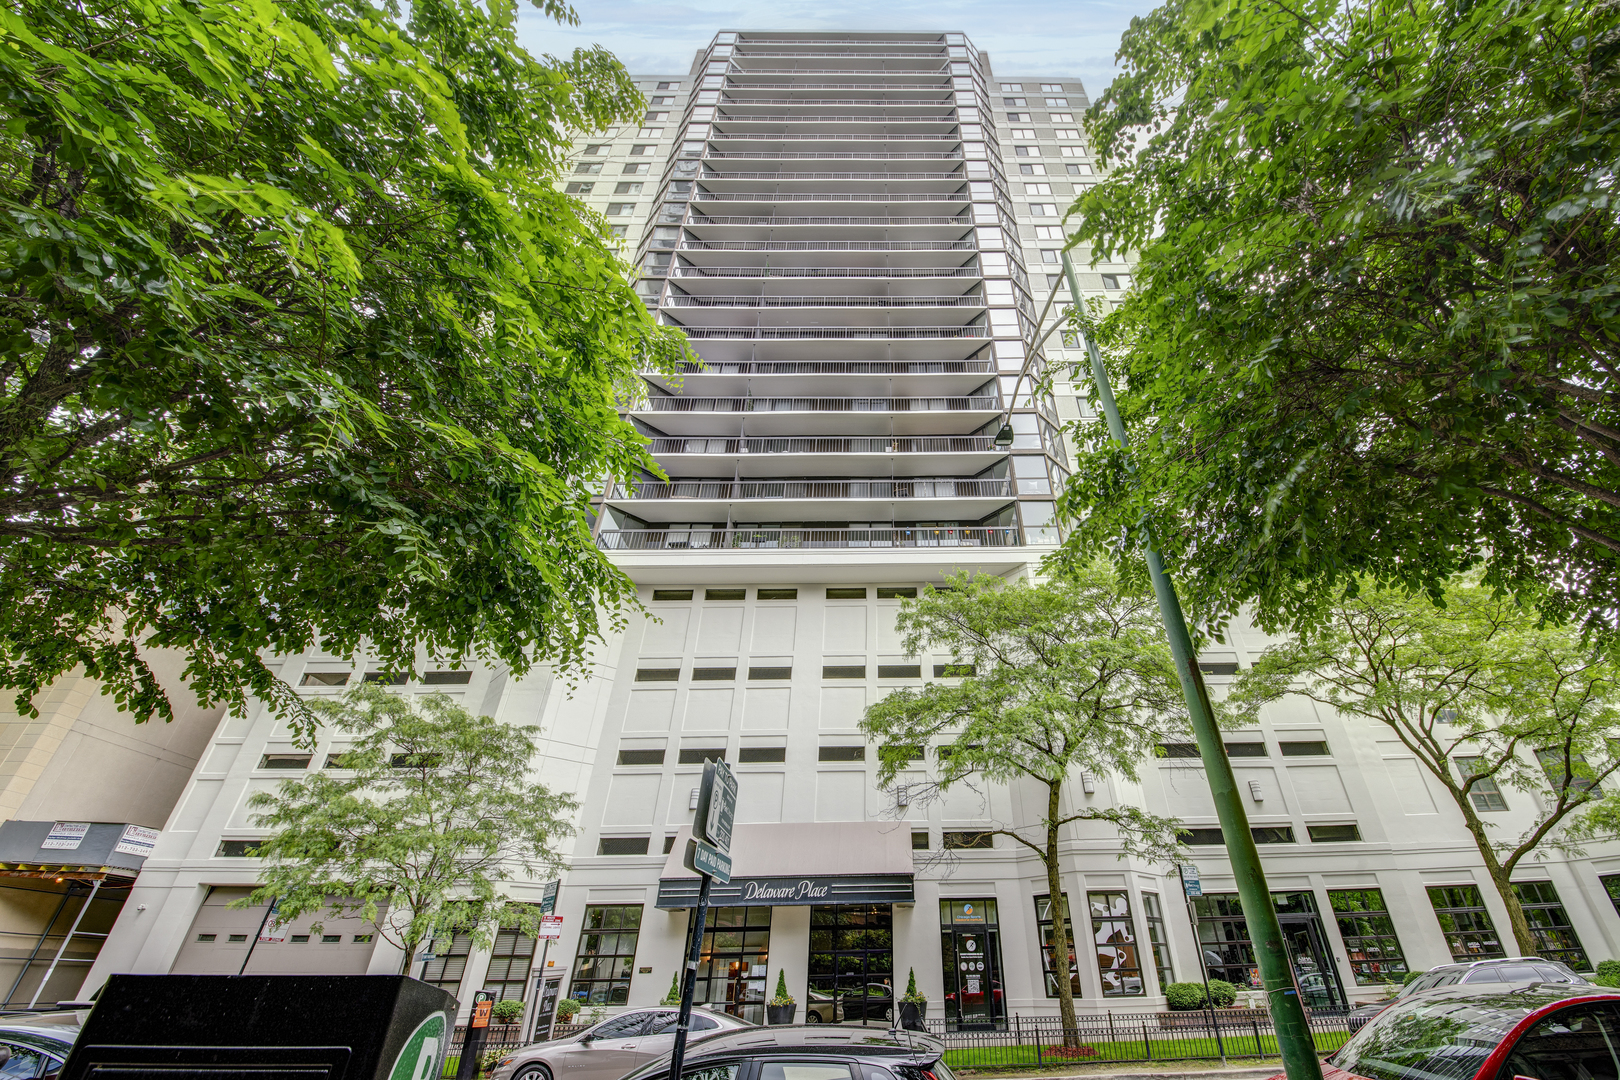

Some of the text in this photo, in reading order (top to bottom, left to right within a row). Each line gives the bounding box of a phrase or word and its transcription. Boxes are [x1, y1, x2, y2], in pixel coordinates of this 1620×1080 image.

[697, 847, 730, 876] 7 DAY PAID PARKING
[743, 880, 828, 900] Delaware Place
